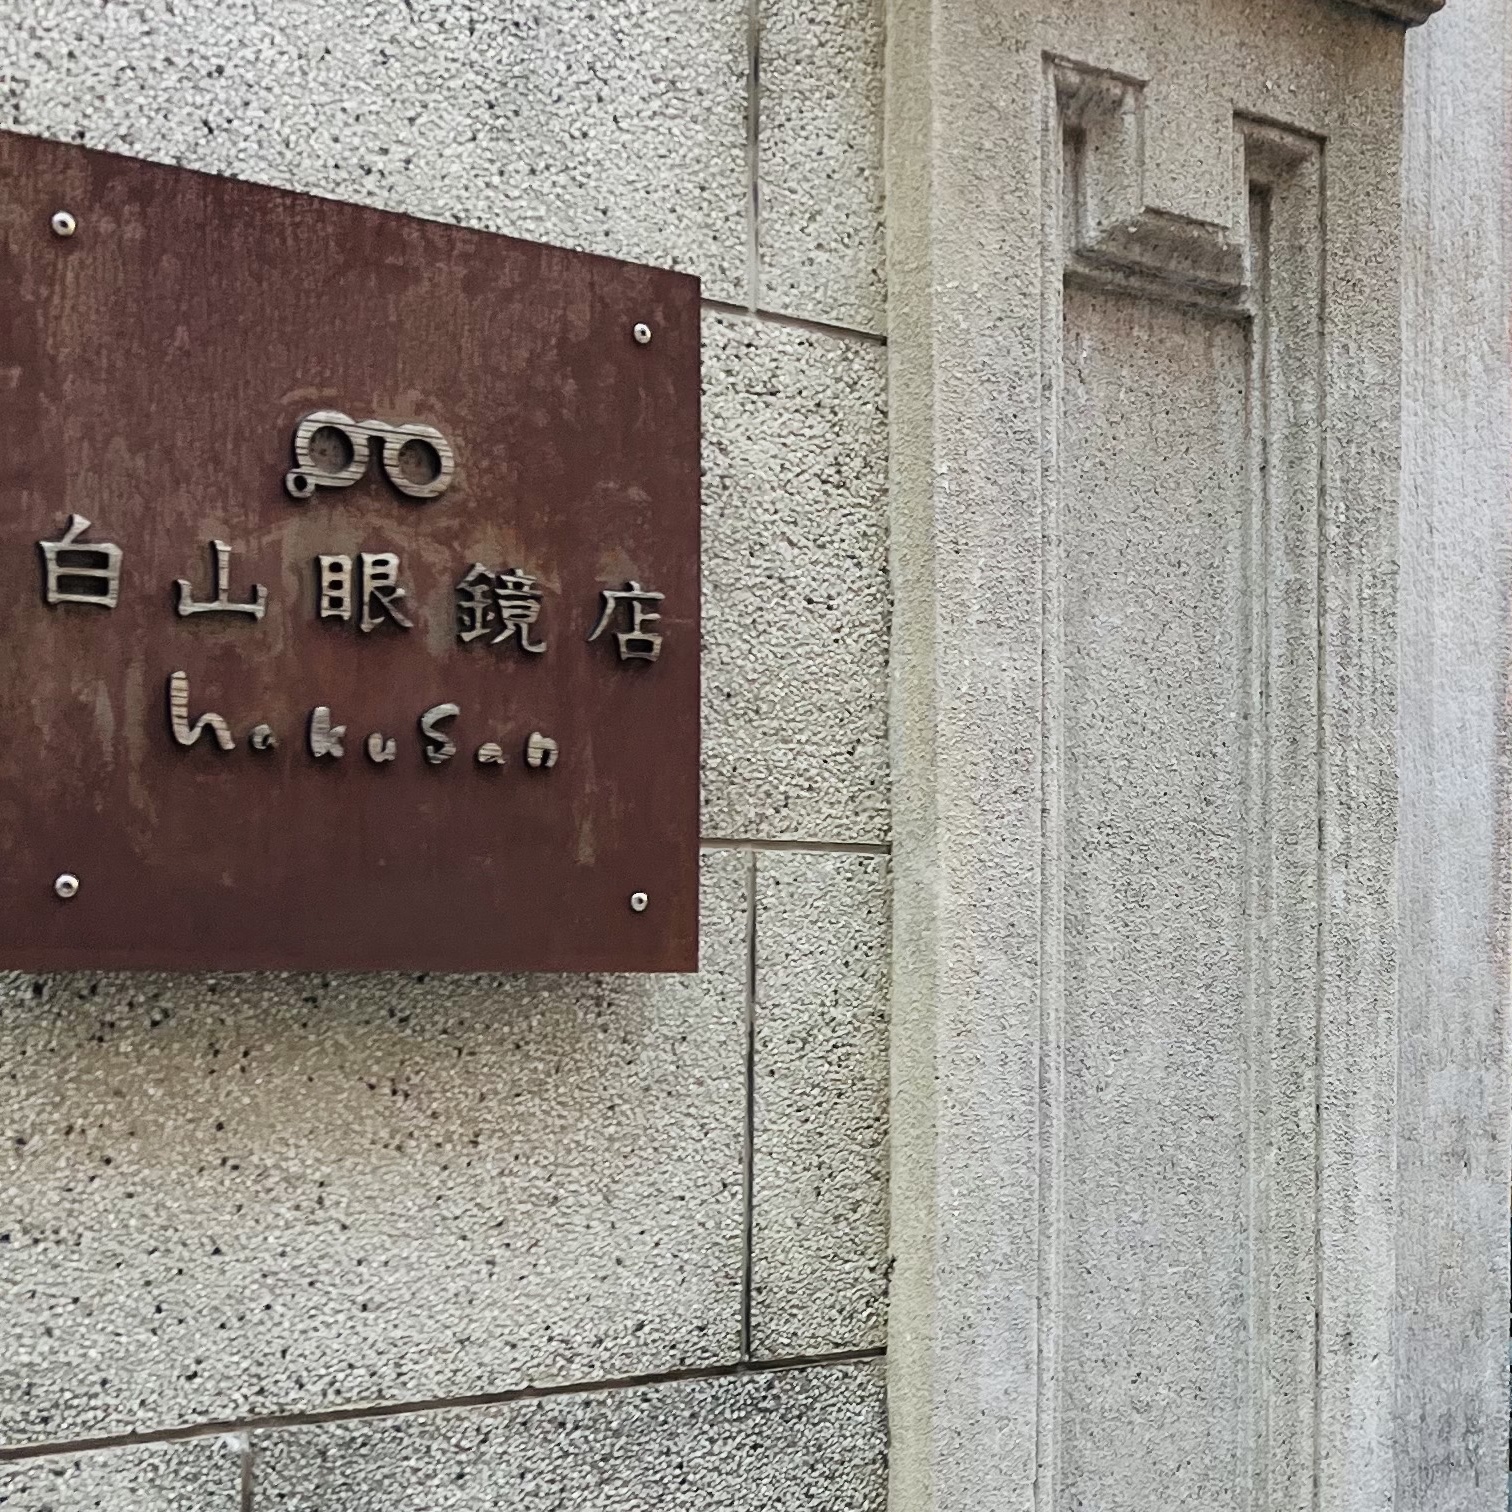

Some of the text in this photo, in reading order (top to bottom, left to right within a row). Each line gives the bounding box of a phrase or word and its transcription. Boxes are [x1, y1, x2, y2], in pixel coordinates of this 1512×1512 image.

[38, 513, 666, 662] 白山眼鏡店
